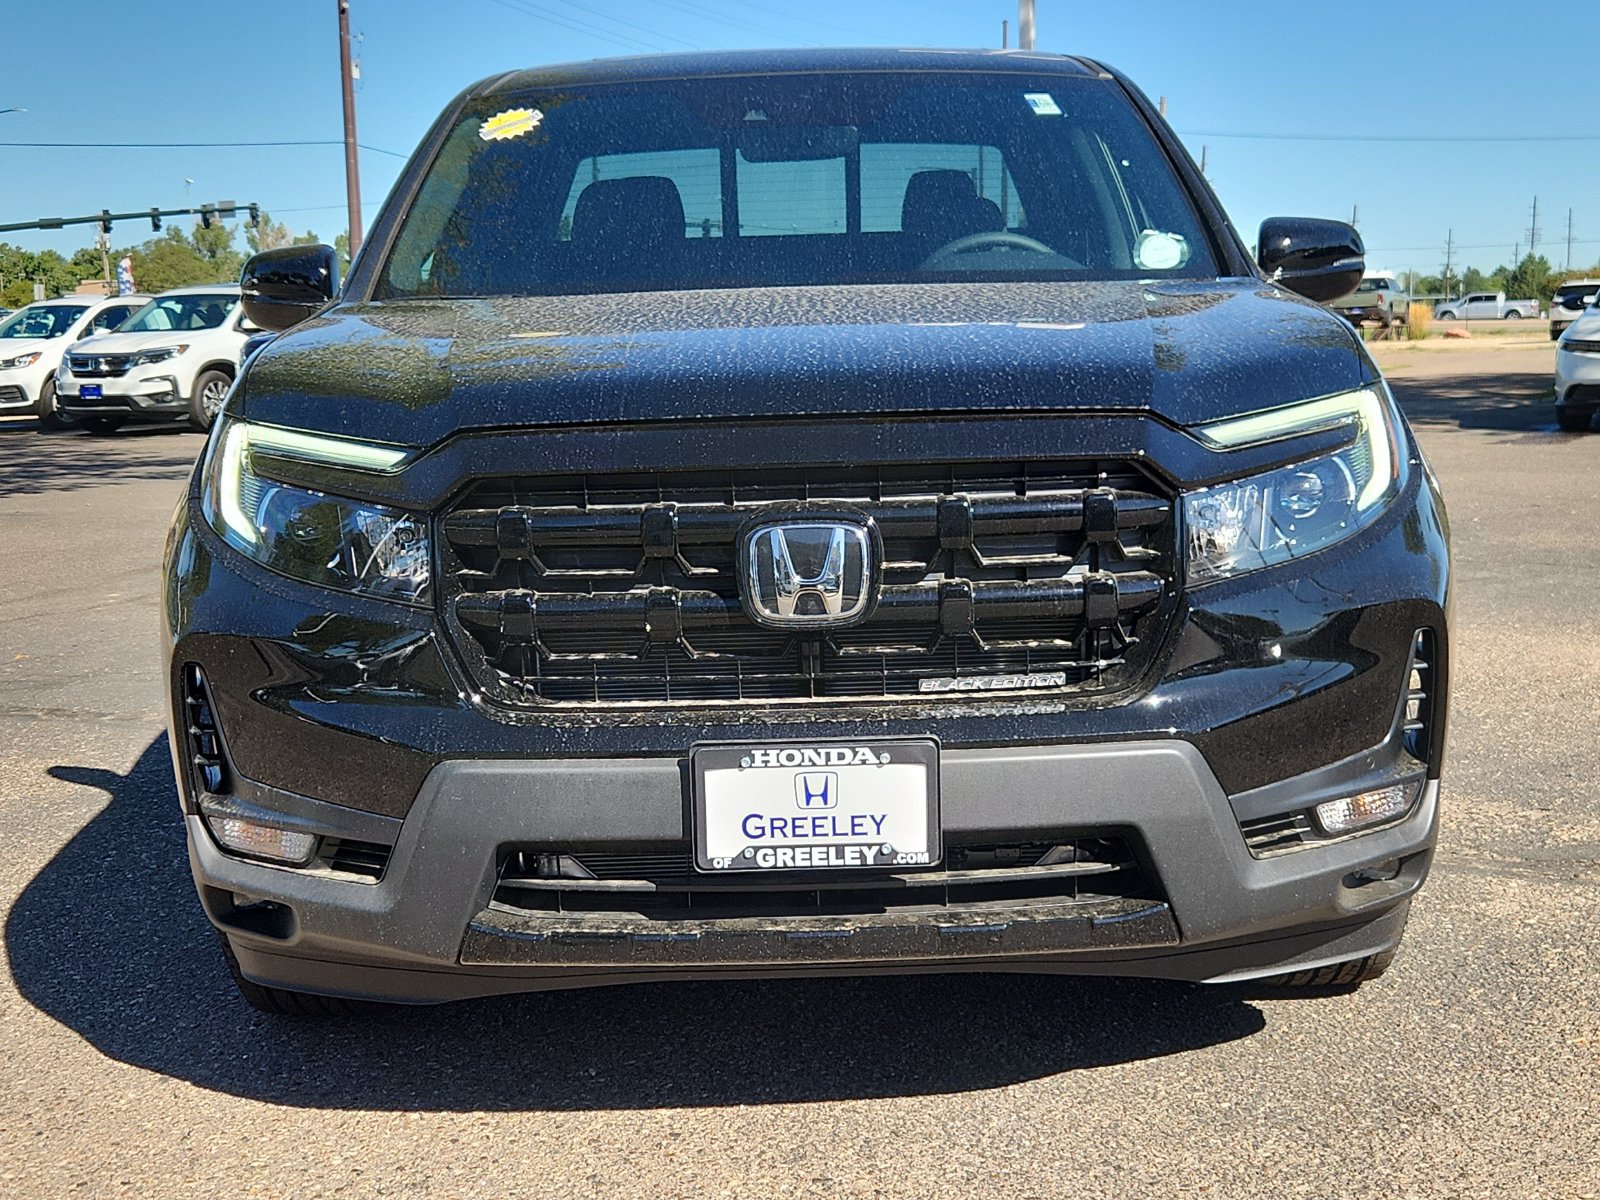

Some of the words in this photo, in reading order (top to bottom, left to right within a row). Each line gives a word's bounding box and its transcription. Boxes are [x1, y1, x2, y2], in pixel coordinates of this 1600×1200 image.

[920, 679, 986, 691] BLACK
[989, 674, 1065, 688] EDITION
[751, 747, 880, 768] HONDA
[741, 813, 889, 840] GREELEY
[712, 857, 733, 869] OF
[755, 845, 880, 868] GREELEY
